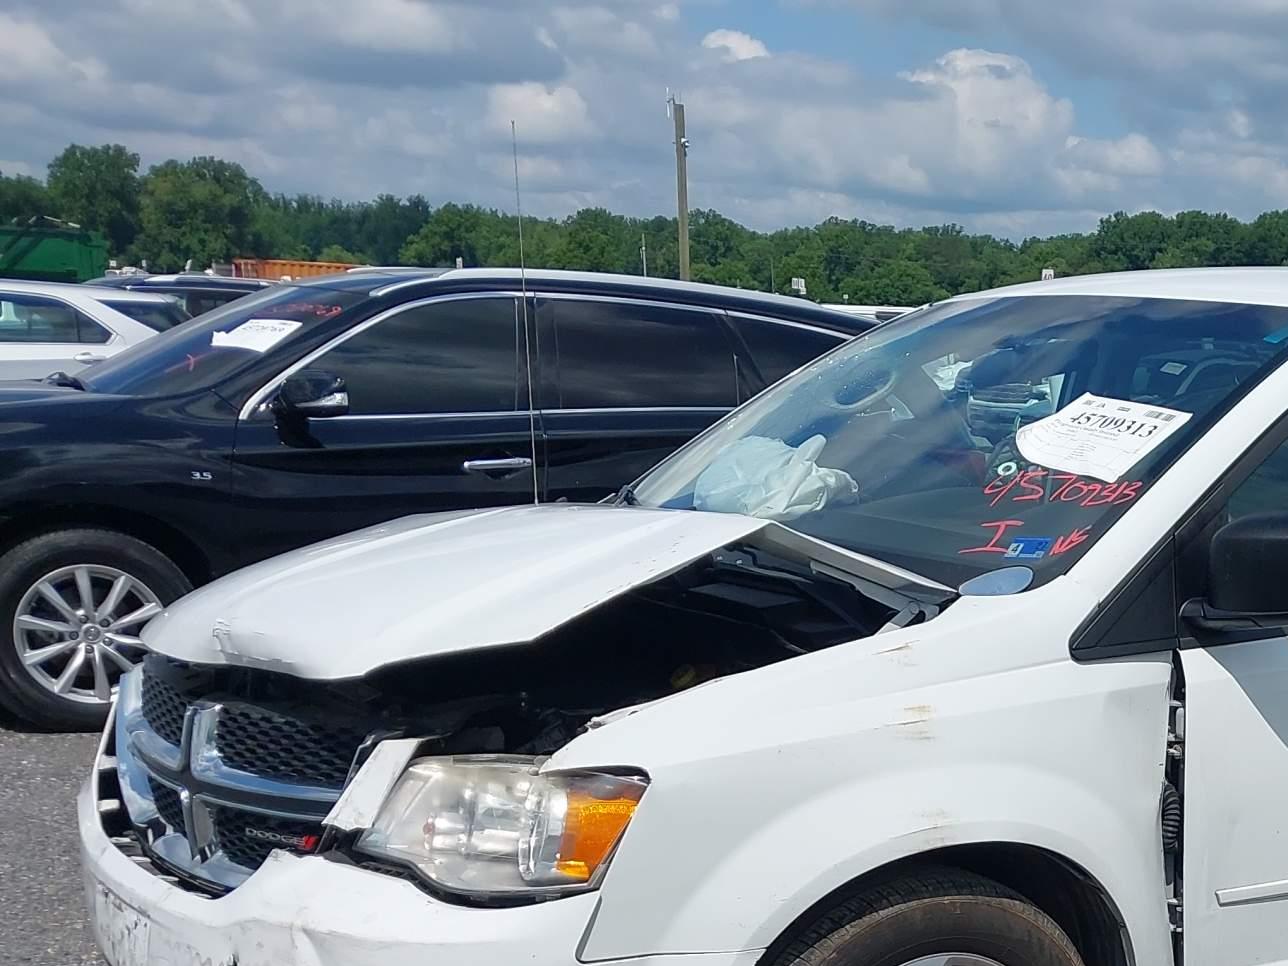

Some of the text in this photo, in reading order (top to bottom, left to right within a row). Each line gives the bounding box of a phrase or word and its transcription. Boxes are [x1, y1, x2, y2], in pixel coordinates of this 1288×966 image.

[1069, 411, 1158, 438] 45709313
[984, 470, 1143, 507] 45709313
[245, 827, 305, 846] DODGE
